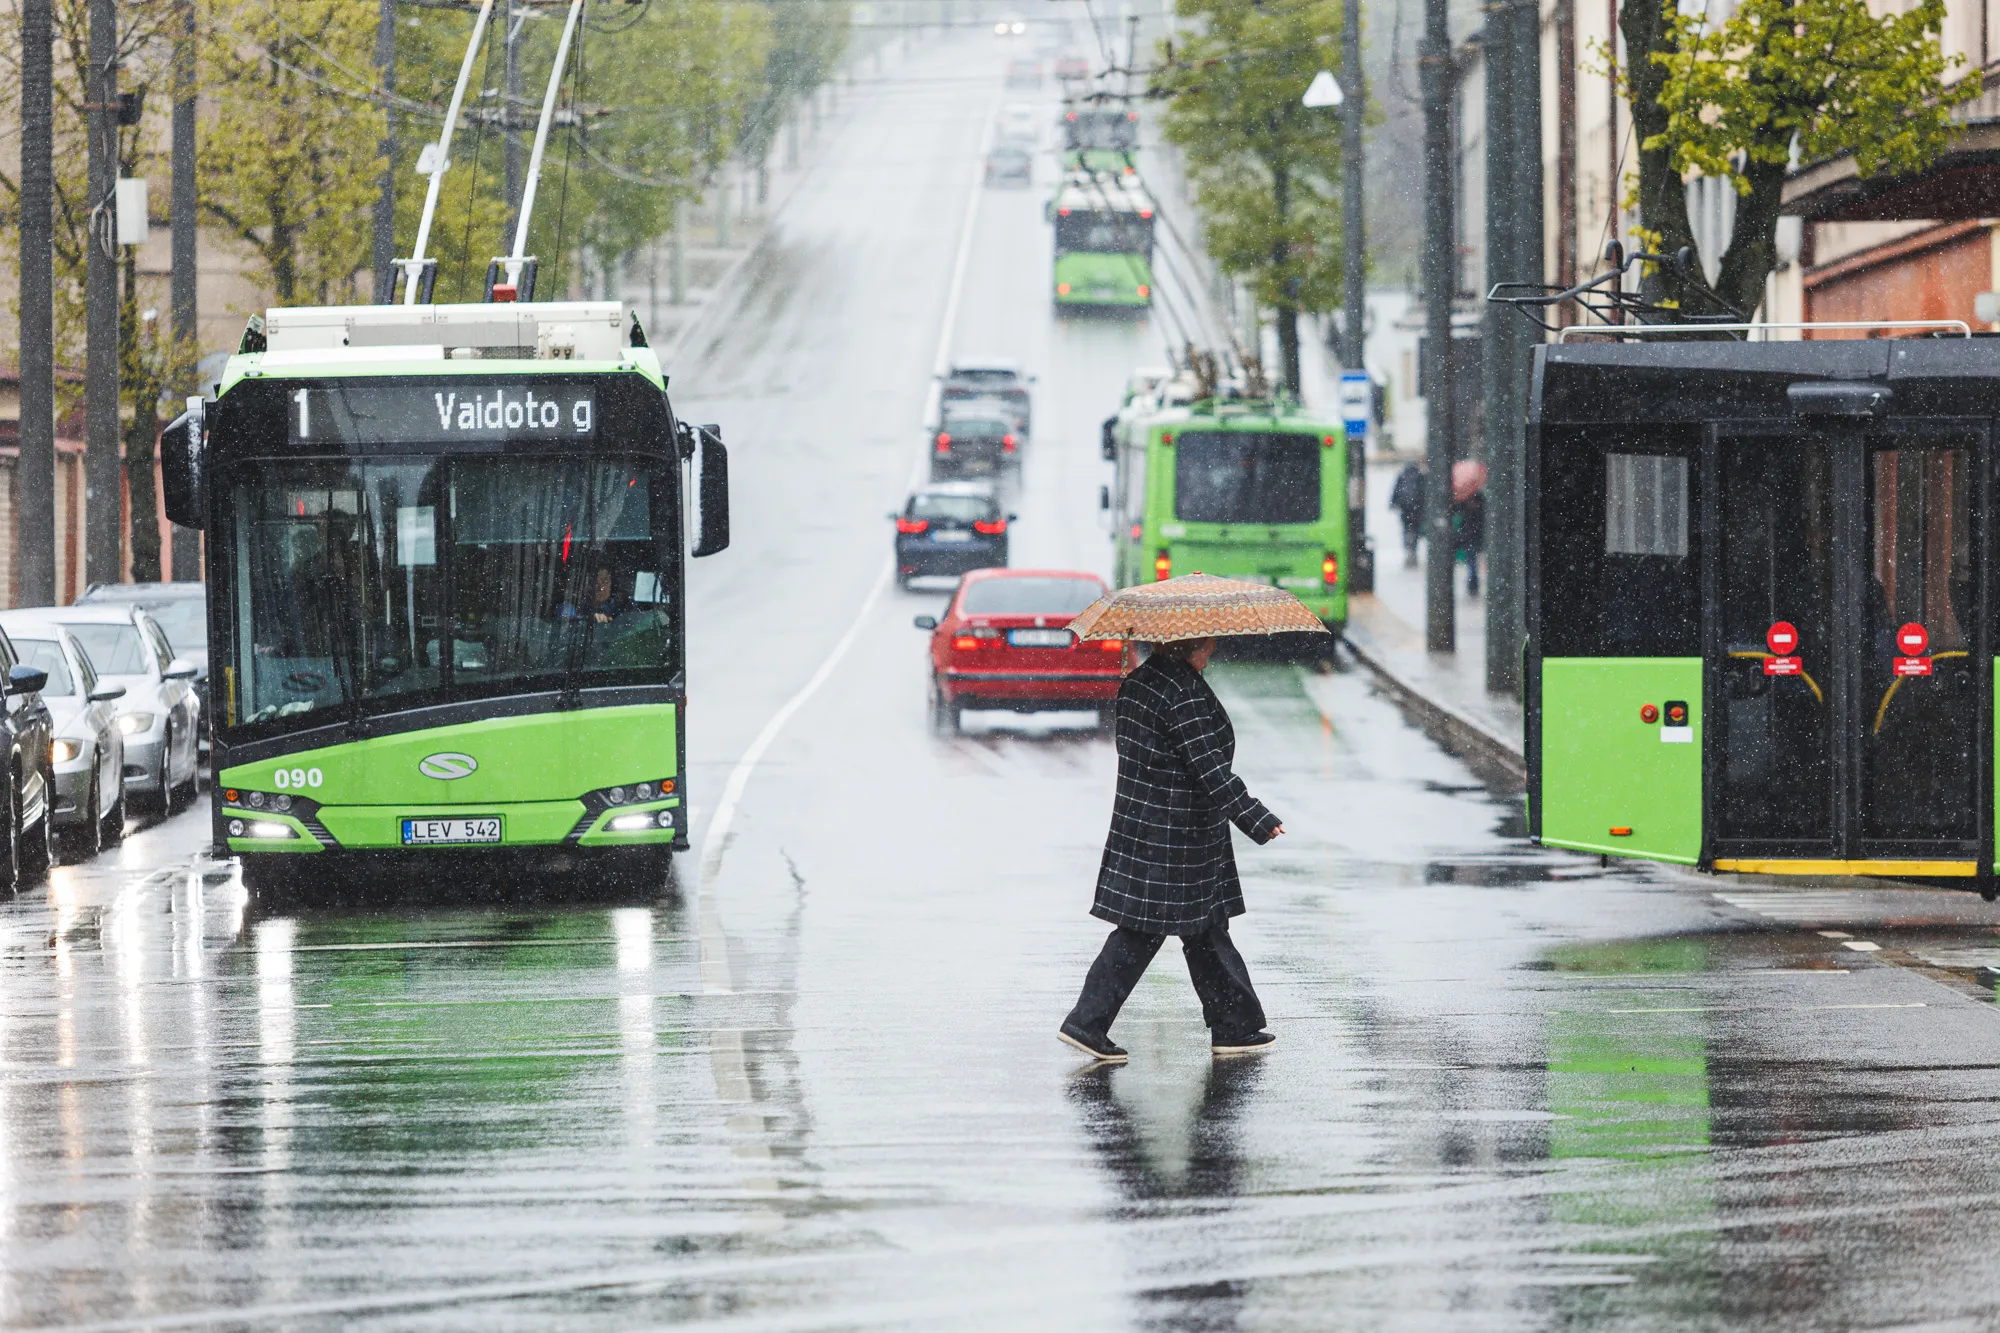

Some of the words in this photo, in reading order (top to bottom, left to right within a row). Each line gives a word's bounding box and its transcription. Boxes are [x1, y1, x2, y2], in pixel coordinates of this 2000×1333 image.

[294, 387, 309, 438] 1
[435, 389, 560, 430] Vaidoto
[572, 400, 592, 433] g
[274, 767, 323, 789] 090
[414, 822, 452, 838] LEV
[465, 821, 497, 837] 542
